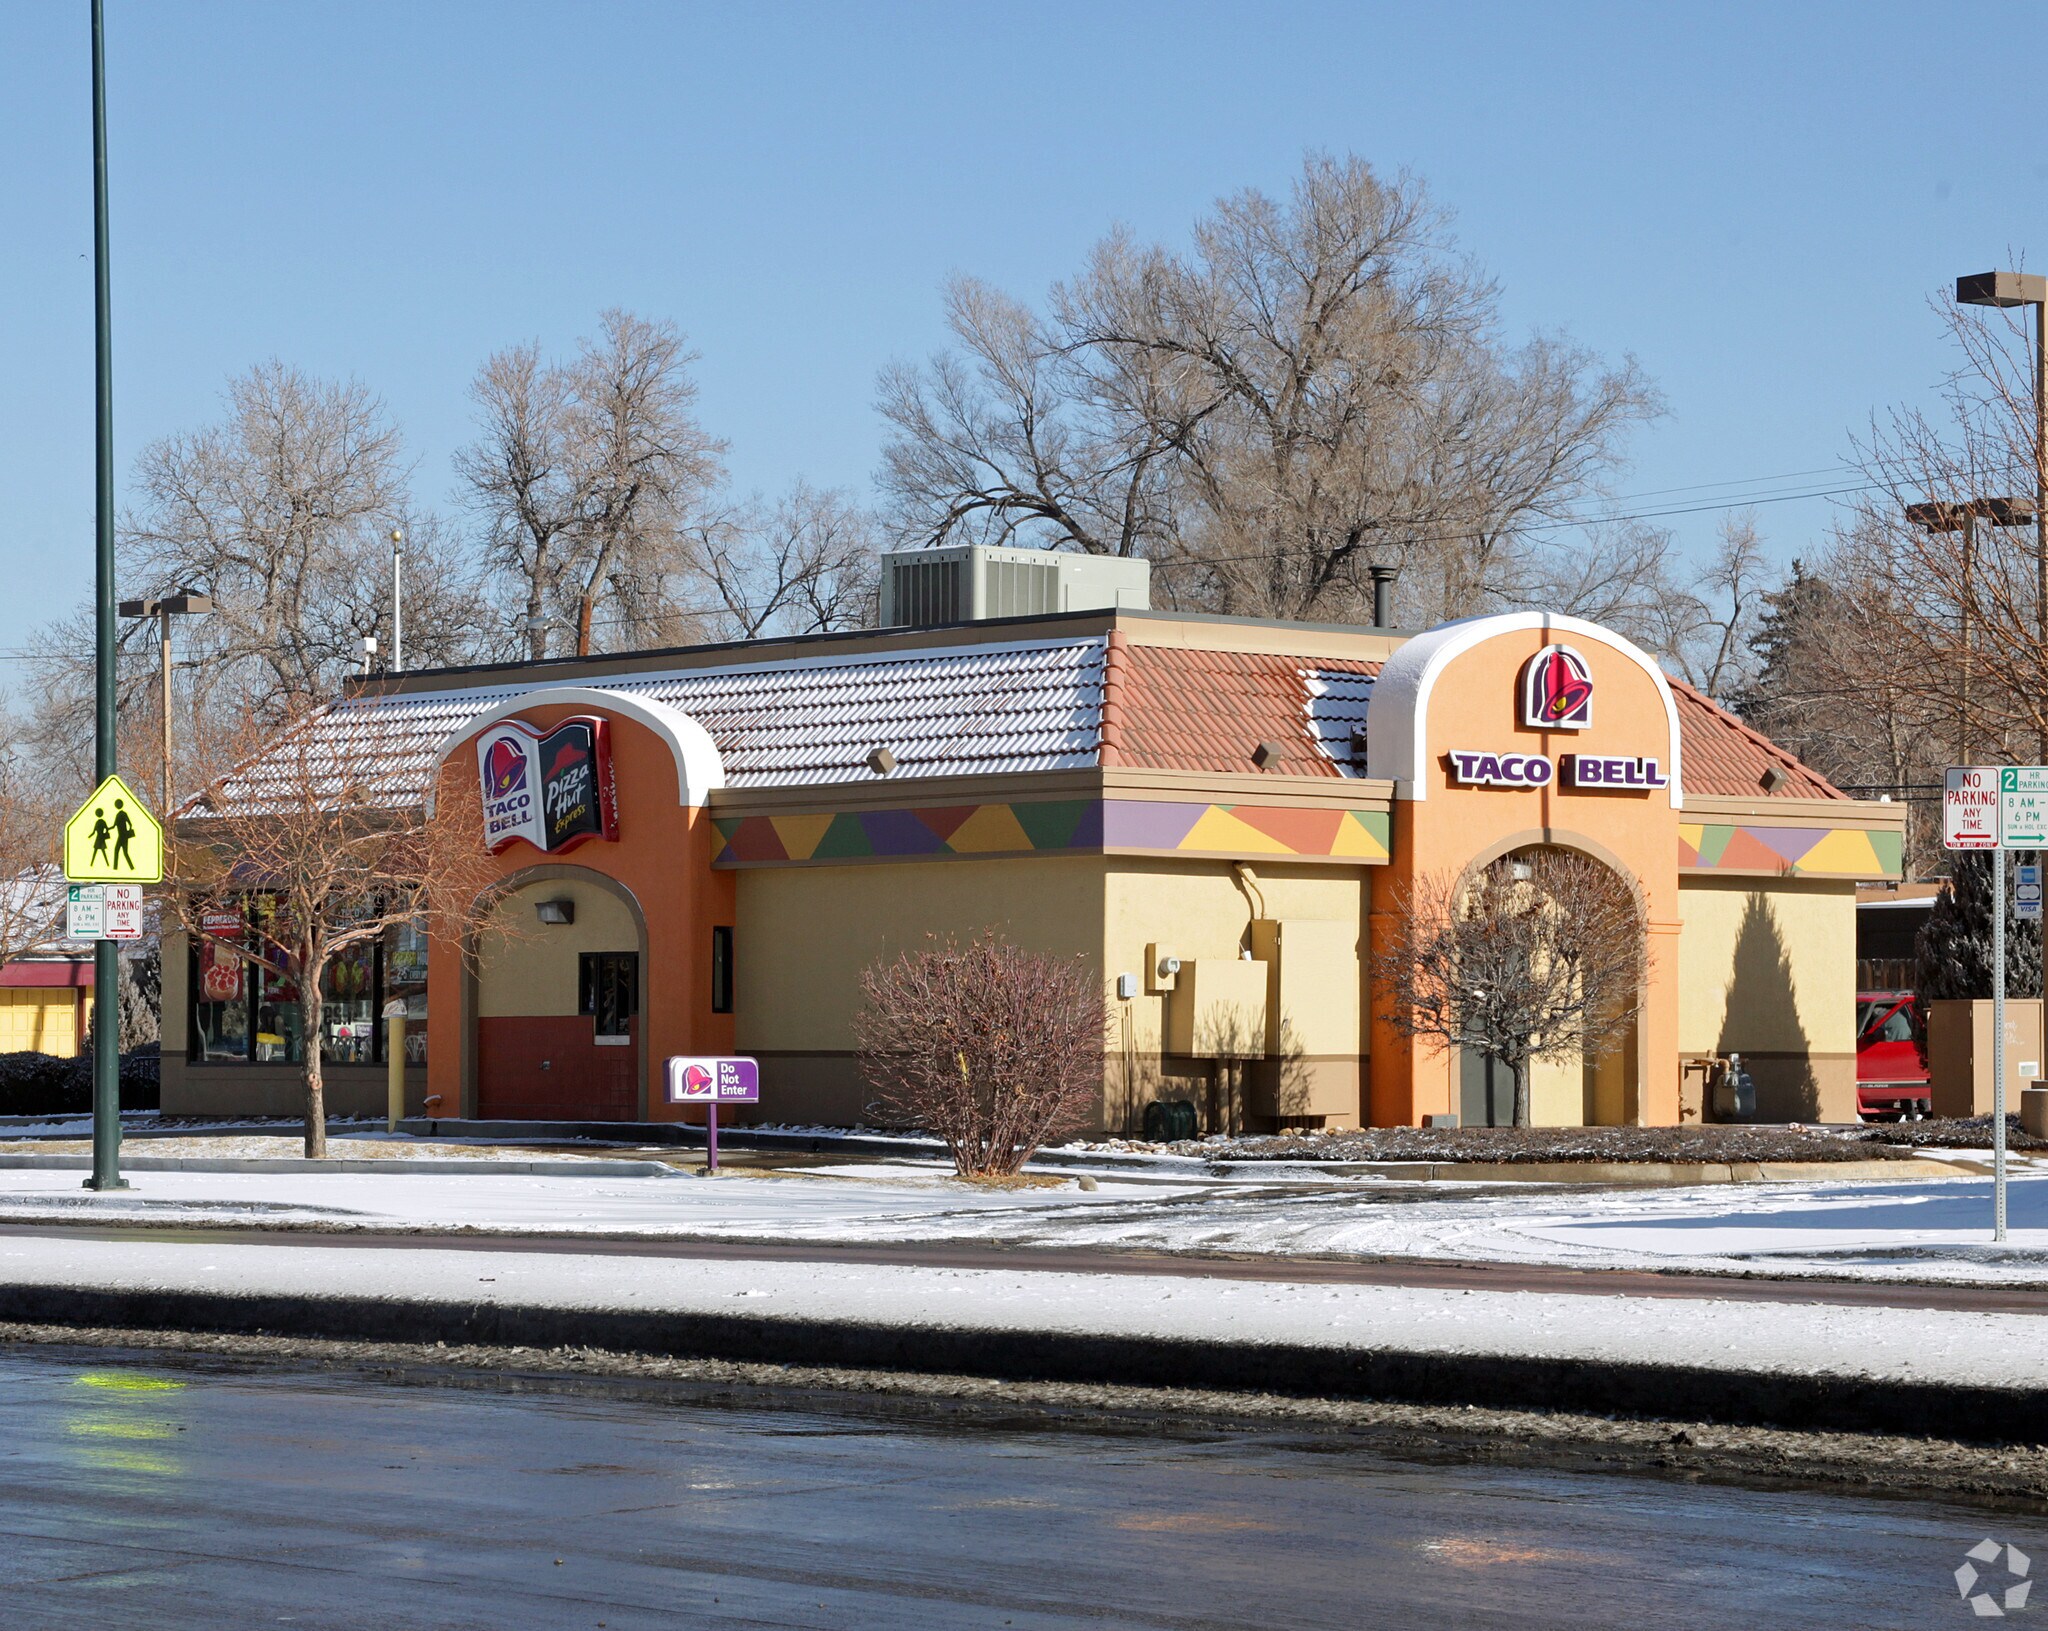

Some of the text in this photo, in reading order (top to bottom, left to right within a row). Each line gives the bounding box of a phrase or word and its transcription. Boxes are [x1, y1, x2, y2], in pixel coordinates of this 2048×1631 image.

[1455, 754, 1667, 785] TACO BELL
[1962, 773, 1981, 788] NO
[2004, 771, 2015, 789] 2
[2029, 772, 2040, 780] HR
[546, 764, 589, 814] Pizza
[555, 783, 586, 819] Hut
[1948, 790, 1996, 806] PARKING
[2008, 797, 2015, 808] 8
[2020, 797, 2035, 808] AM
[486, 793, 530, 818] TACO
[554, 803, 587, 834] Express
[1962, 808, 1982, 818] ANY
[2014, 811, 2040, 822] 6 PM
[489, 810, 533, 834] BELL
[1962, 820, 1983, 830] TIME
[70, 888, 79, 900] 2
[117, 889, 130, 899] NO
[107, 900, 140, 911] PARKING
[116, 919, 130, 927] TIME
[721, 1063, 735, 1074] Do
[721, 1074, 739, 1085] Not
[721, 1085, 747, 1095] Enter
